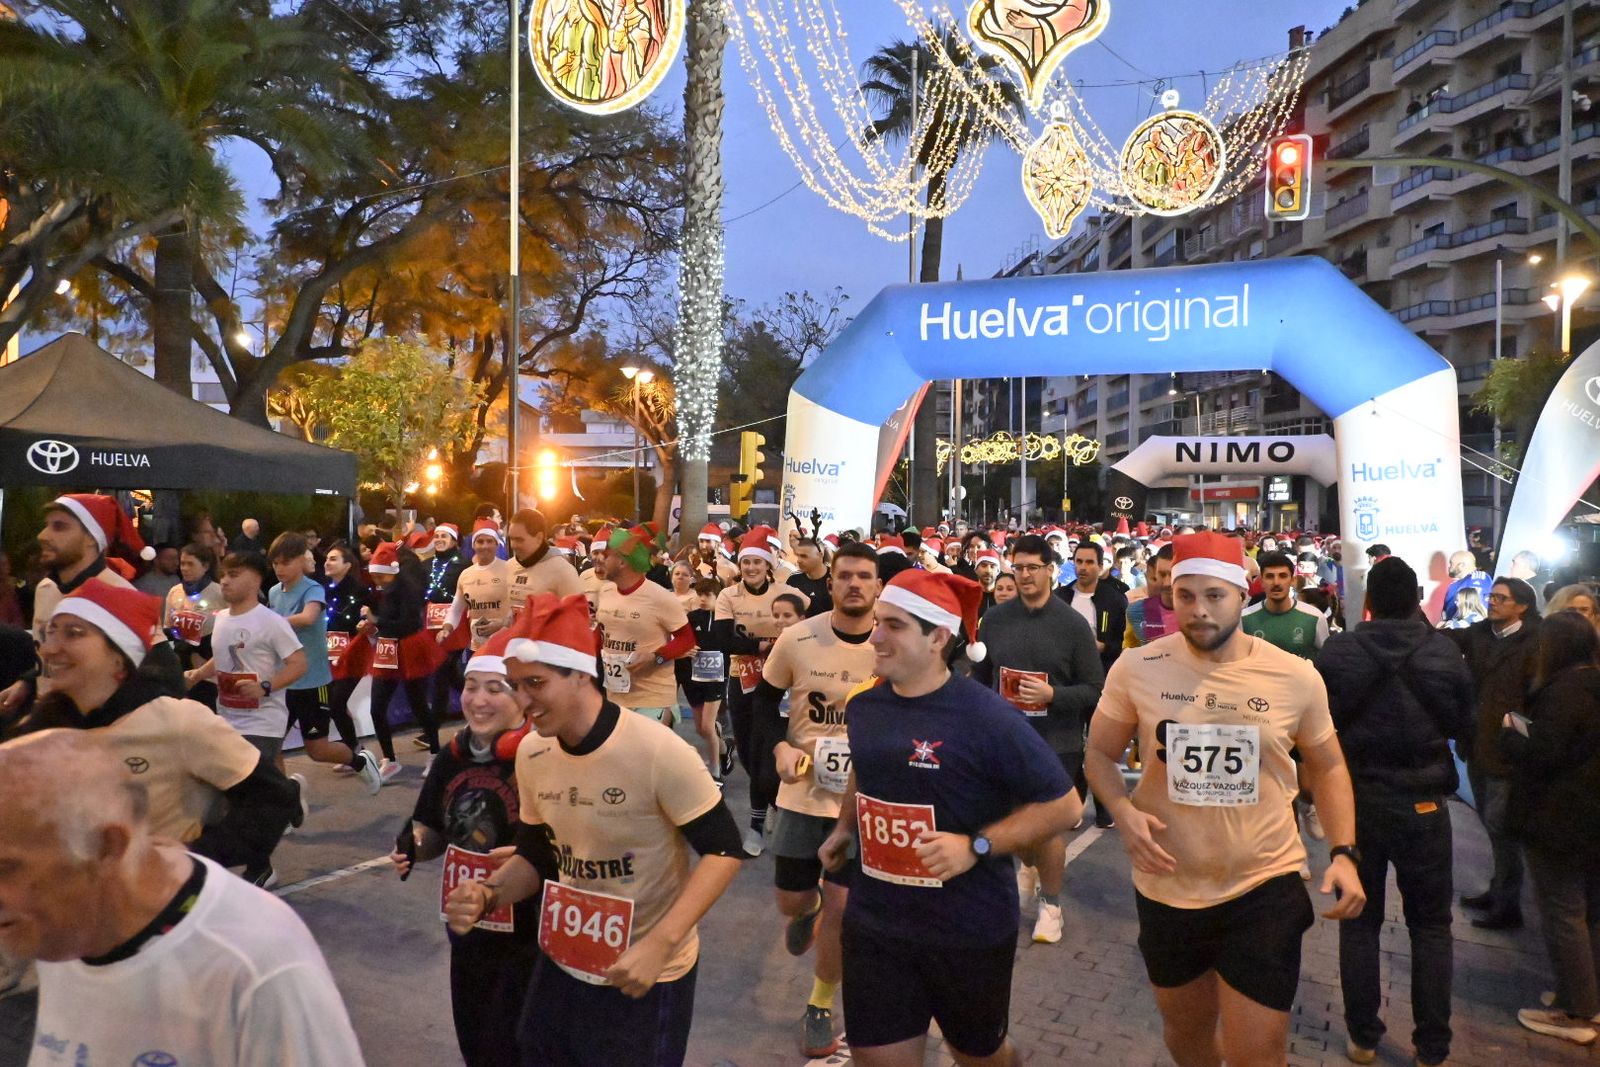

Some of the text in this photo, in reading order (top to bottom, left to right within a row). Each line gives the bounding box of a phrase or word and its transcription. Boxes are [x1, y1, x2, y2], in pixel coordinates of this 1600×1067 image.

[920, 283, 1250, 342] Huelva original
[91, 451, 151, 468] HUELVA
[1175, 441, 1296, 463] NIMO
[785, 457, 842, 476] Huelva
[1351, 459, 1438, 482] Huelva
[796, 509, 835, 521] HUVA
[1384, 522, 1439, 536] HUELVA
[172, 614, 202, 631] 2175
[693, 656, 722, 670] 2523
[739, 658, 764, 677] 213
[1160, 691, 1197, 702] Huelva
[1183, 745, 1243, 775] 575
[1212, 781, 1252, 791] VAZQUEZ
[861, 810, 930, 849] 1852
[547, 900, 625, 949] 1946
